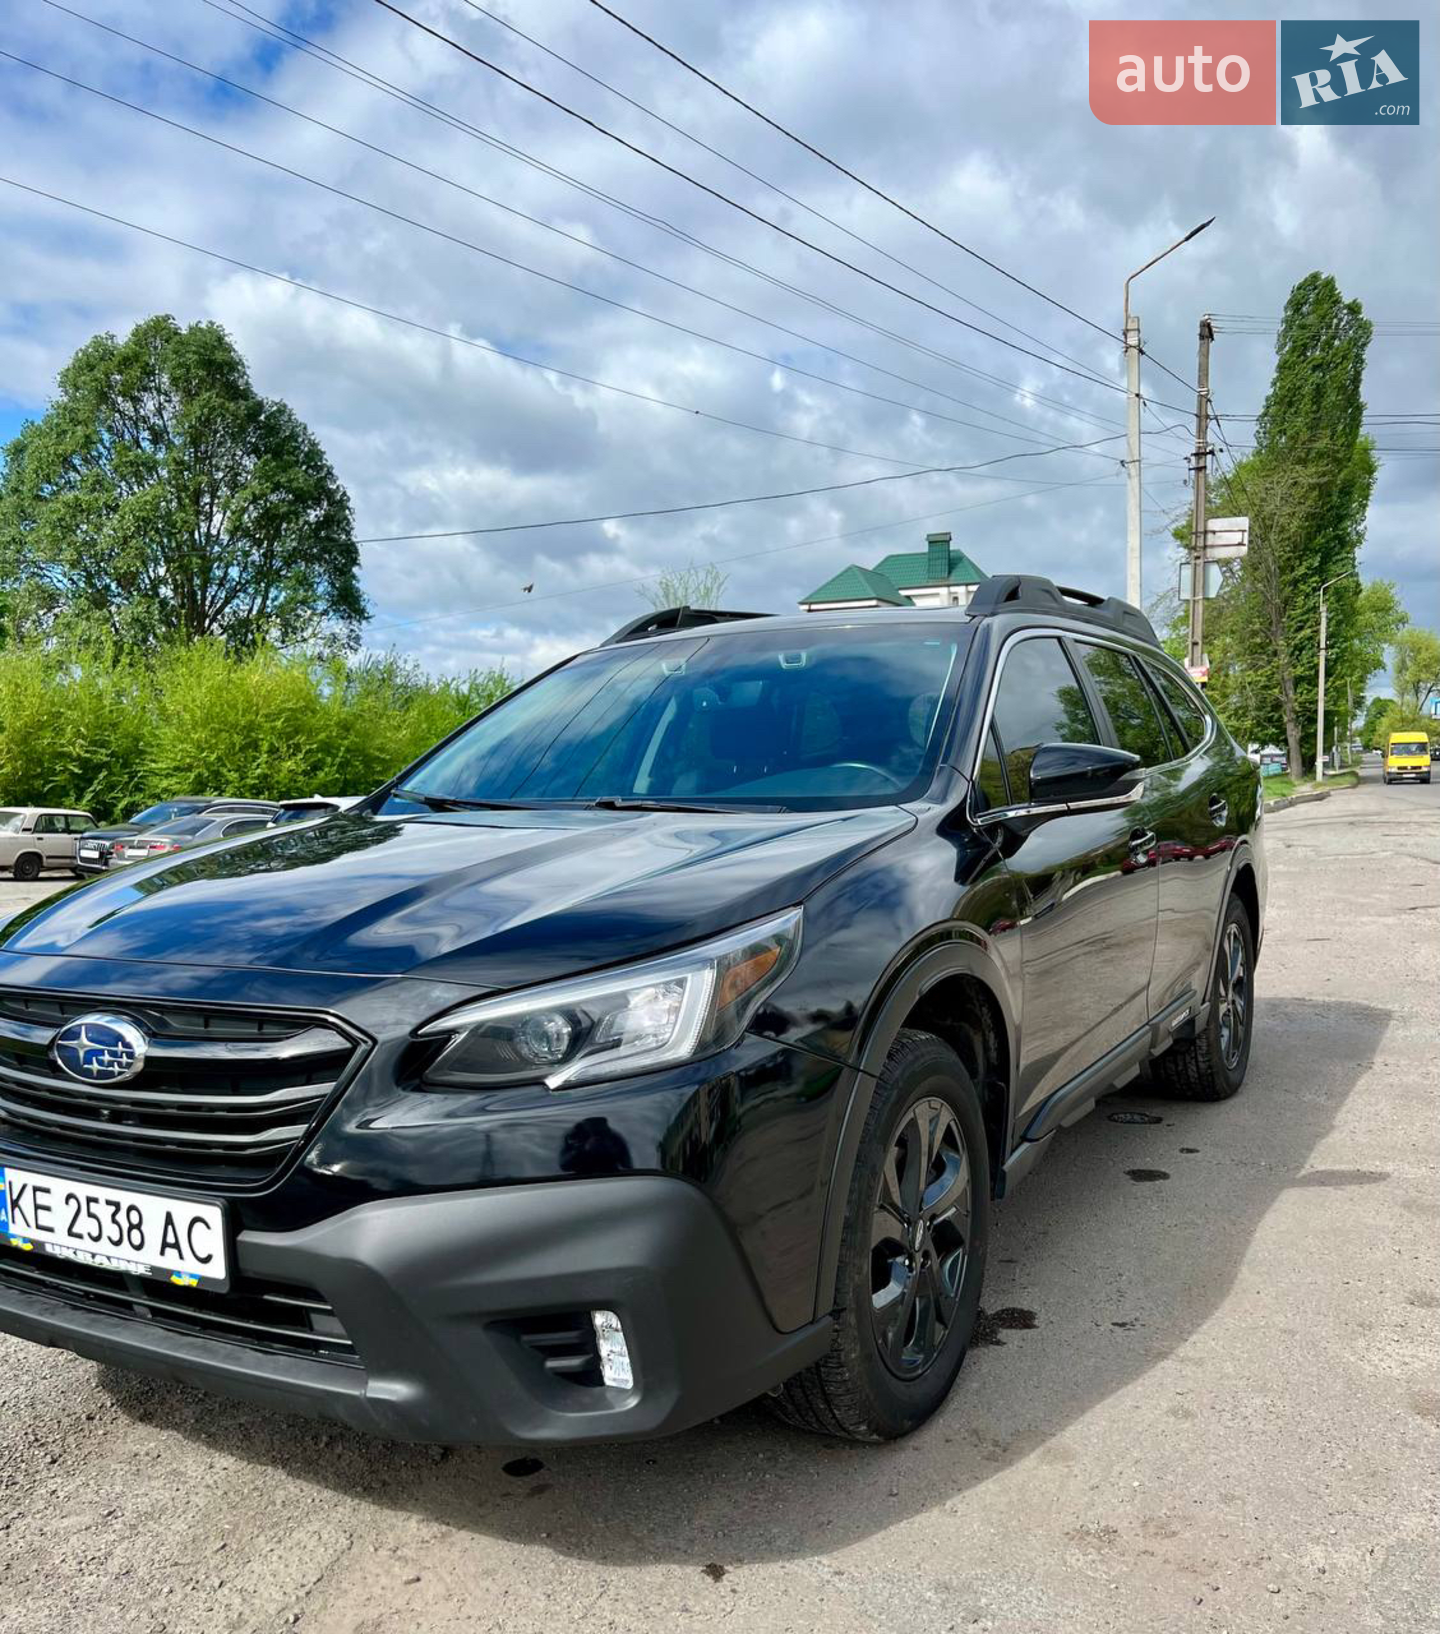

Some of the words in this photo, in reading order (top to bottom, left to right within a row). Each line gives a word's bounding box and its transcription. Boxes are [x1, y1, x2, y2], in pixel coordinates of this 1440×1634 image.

[9, 1180, 55, 1233] KE
[64, 1192, 146, 1251] 2538
[159, 1210, 214, 1265] AC
